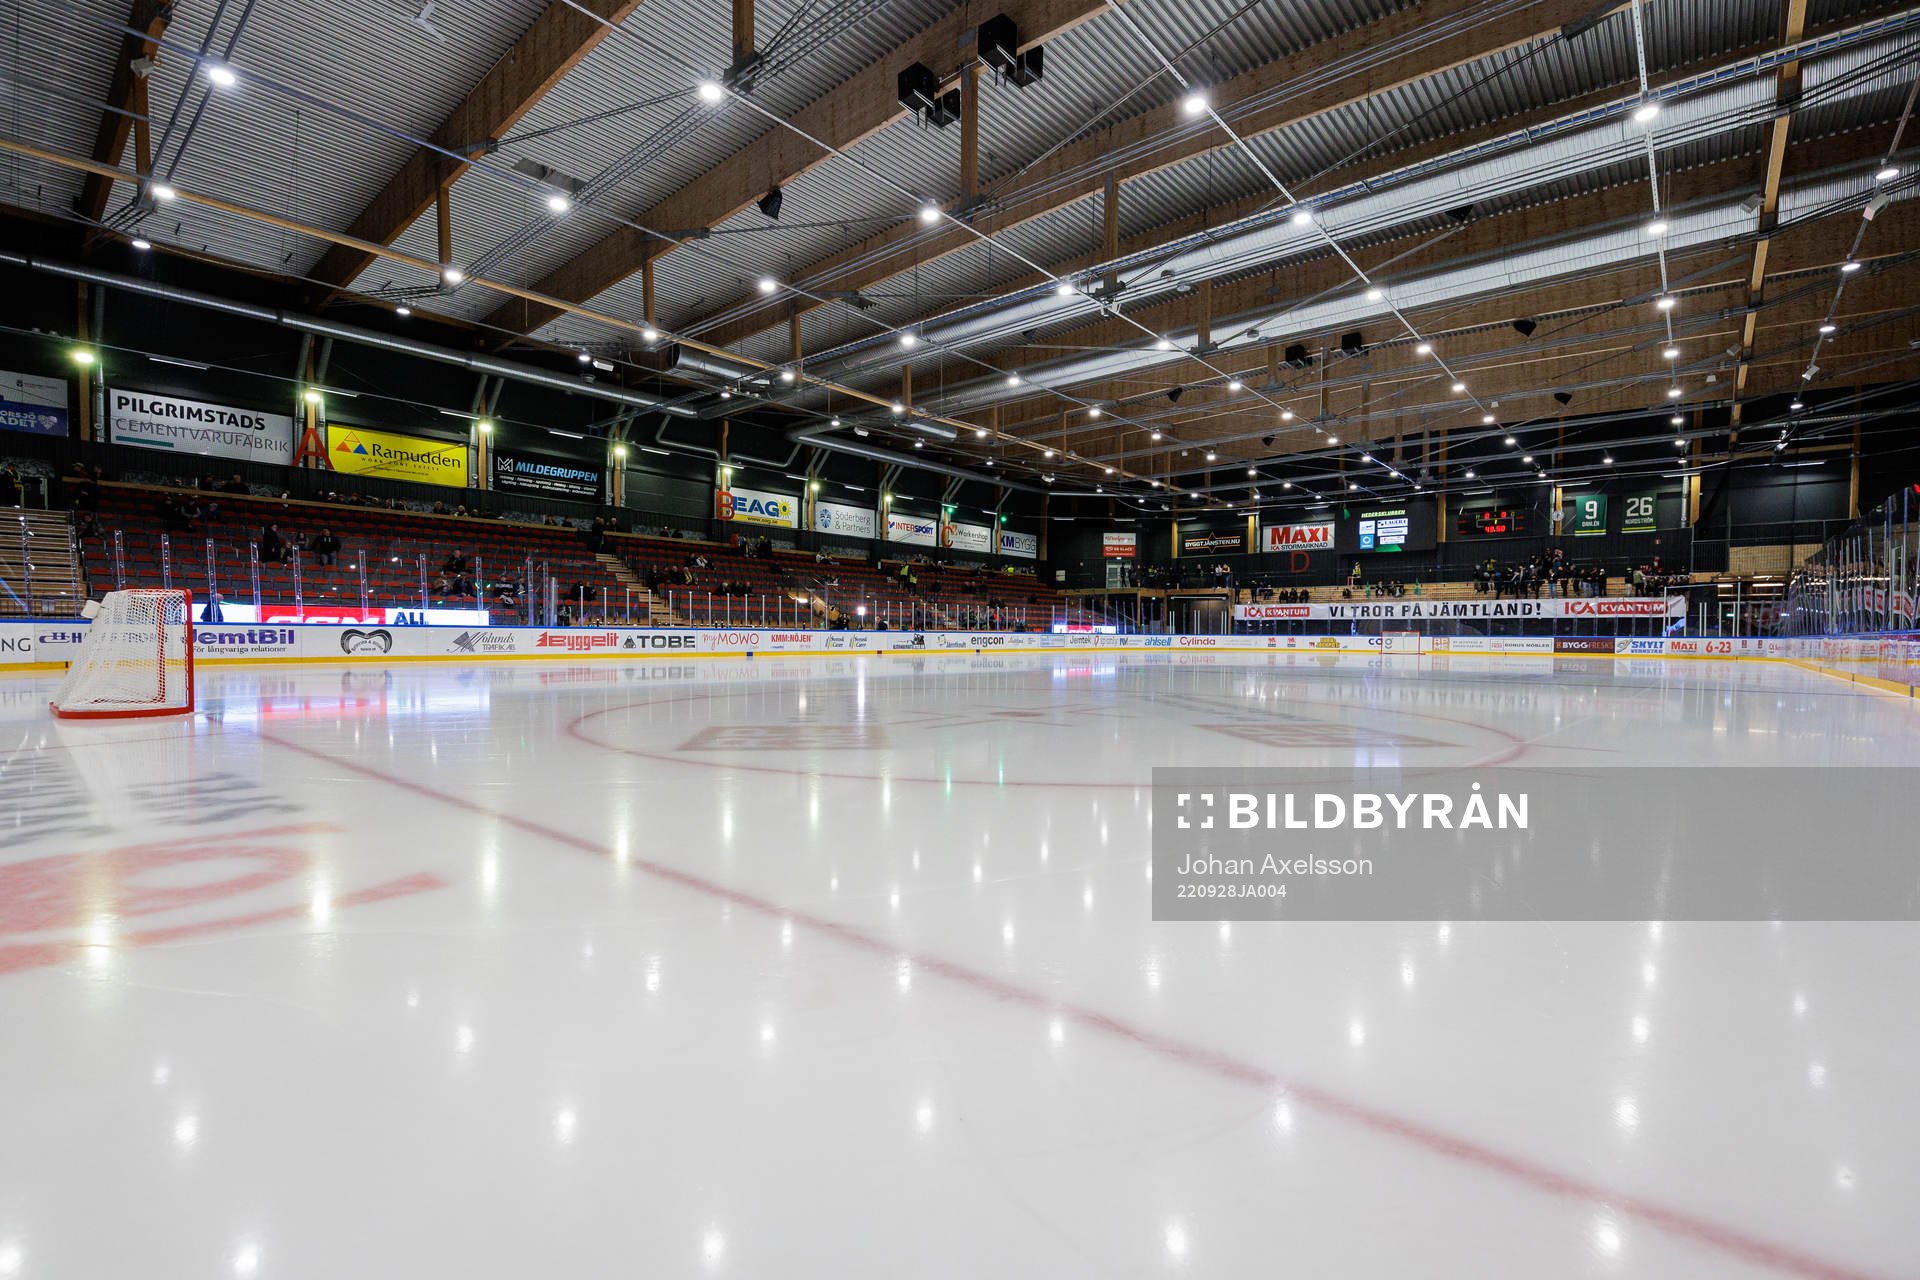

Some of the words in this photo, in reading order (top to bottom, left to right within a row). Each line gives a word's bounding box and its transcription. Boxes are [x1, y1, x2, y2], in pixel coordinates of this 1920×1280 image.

[117, 396, 265, 431] PILGRIMSTADS
[116, 418, 289, 452] CEMENTVARUFABRIK
[293, 427, 335, 470] A
[372, 443, 461, 468] Ramudden
[515, 461, 598, 482] MILDEGRUPPEN
[716, 490, 735, 520] B
[1585, 500, 1598, 519] 9
[1626, 497, 1653, 516] 26
[895, 521, 933, 535] INTERSPORT
[941, 526, 954, 548] C
[1271, 527, 1328, 545] MAXI
[1290, 550, 1310, 573] D
[1244, 607, 1264, 617] ICA
[1266, 608, 1309, 616] KVANTUM
[1330, 606, 1344, 617] VI
[1351, 605, 1394, 617] TROR
[1402, 603, 1422, 617] PÅ
[1429, 602, 1541, 617] JÄMTLAND!
[1564, 601, 1595, 614] ICA
[1601, 604, 1664, 612] KVANTUM
[207, 646, 249, 654] långvariga
[549, 632, 619, 651] Byggelit
[637, 635, 696, 648] TOBE
[971, 635, 1004, 648] engcon
[1144, 637, 1172, 647] ahlsell
[1180, 637, 1216, 647] Cylinda
[1706, 641, 1731, 653] 6-23
